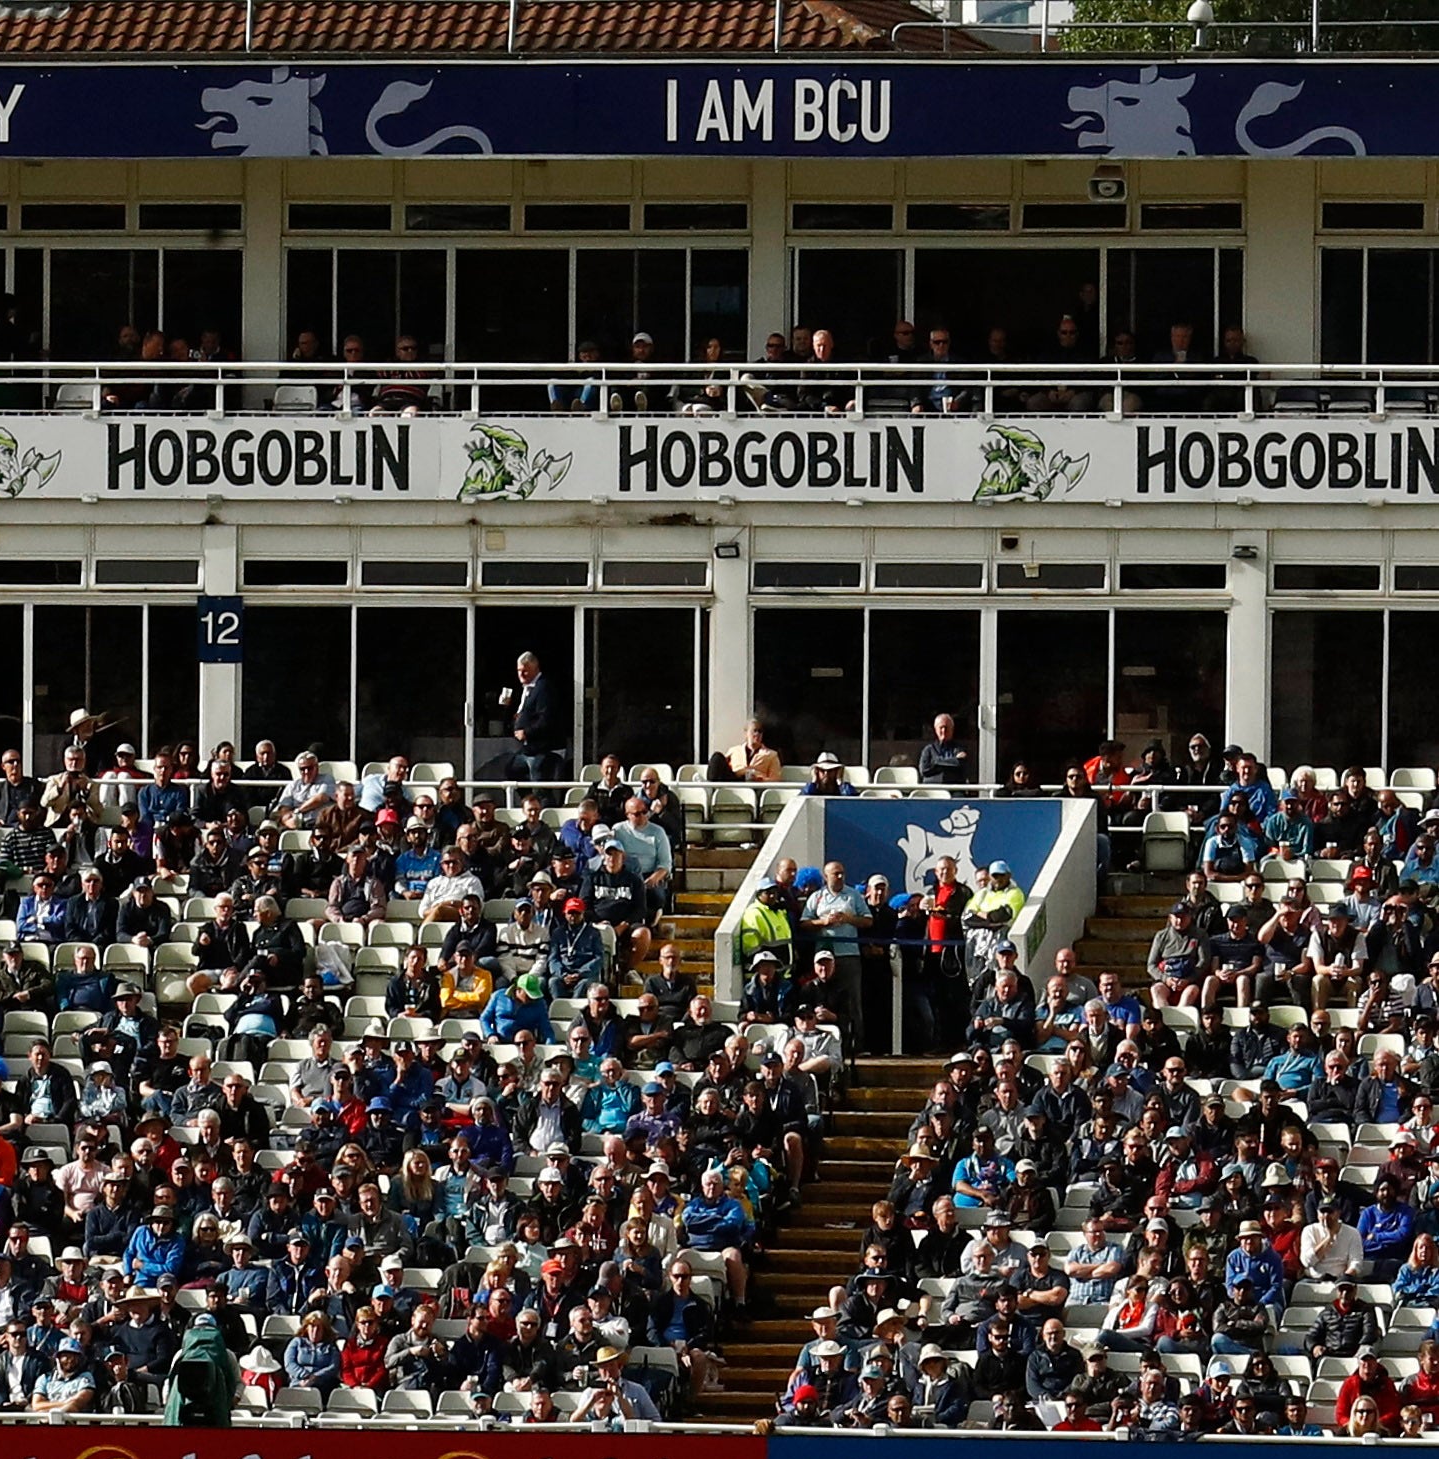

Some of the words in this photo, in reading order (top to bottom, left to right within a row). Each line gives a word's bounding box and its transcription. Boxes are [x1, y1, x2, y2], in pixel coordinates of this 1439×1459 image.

[667, 80, 677, 141] I
[696, 79, 773, 141] AM
[795, 79, 890, 142] BCU
[107, 424, 410, 490] HOBGOBLIN
[619, 425, 925, 492] HOBGOBLIN
[1137, 426, 1439, 494] HOBGOBLIN
[201, 612, 238, 643] 12
